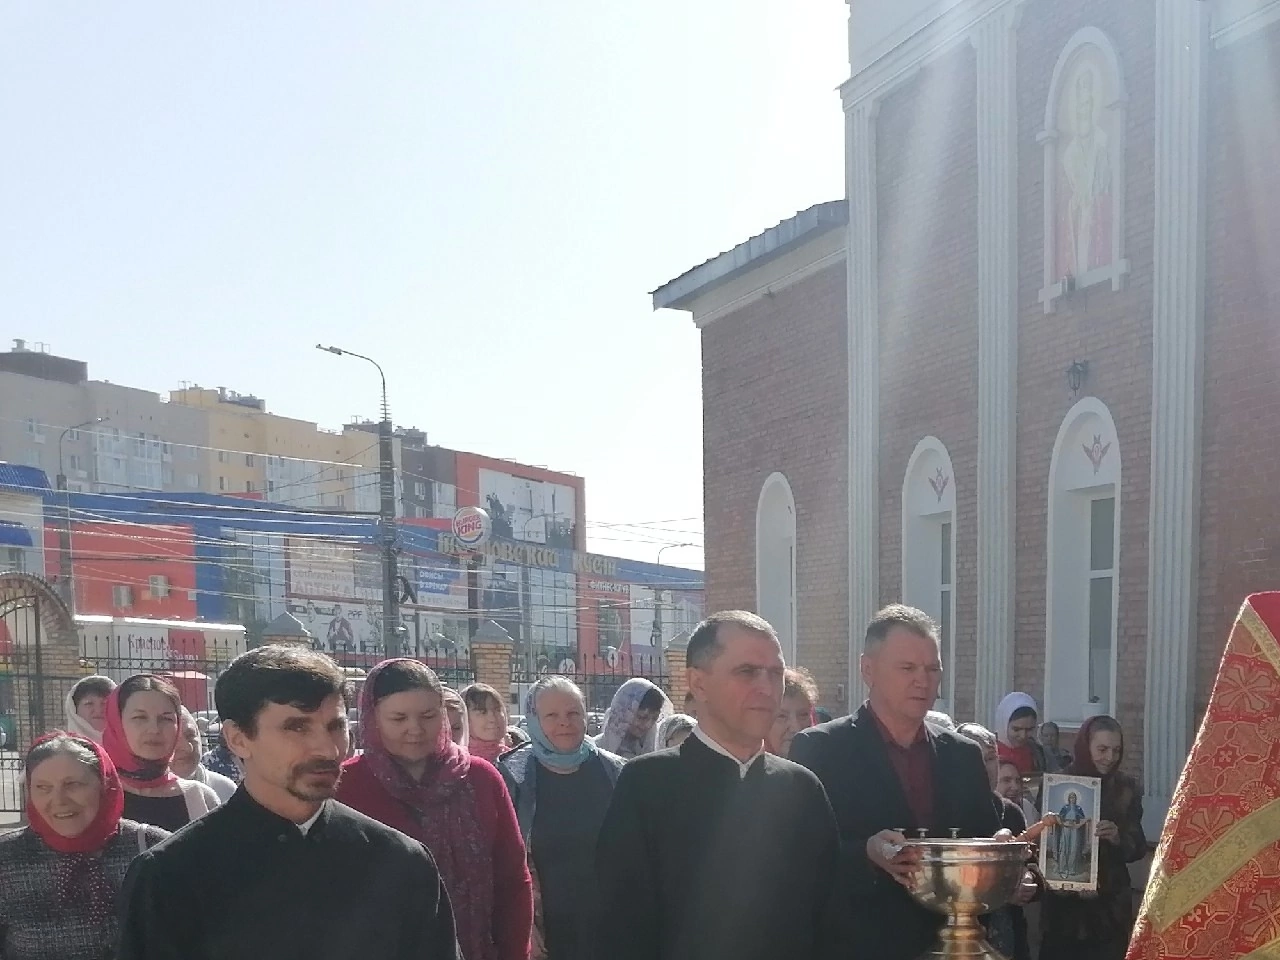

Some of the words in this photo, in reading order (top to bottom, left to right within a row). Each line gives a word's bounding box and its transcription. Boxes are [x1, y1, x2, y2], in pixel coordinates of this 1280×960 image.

[456, 513, 481, 527] BURGER
[458, 519, 482, 536] KING
[294, 582, 352, 598] АПТЕКА
